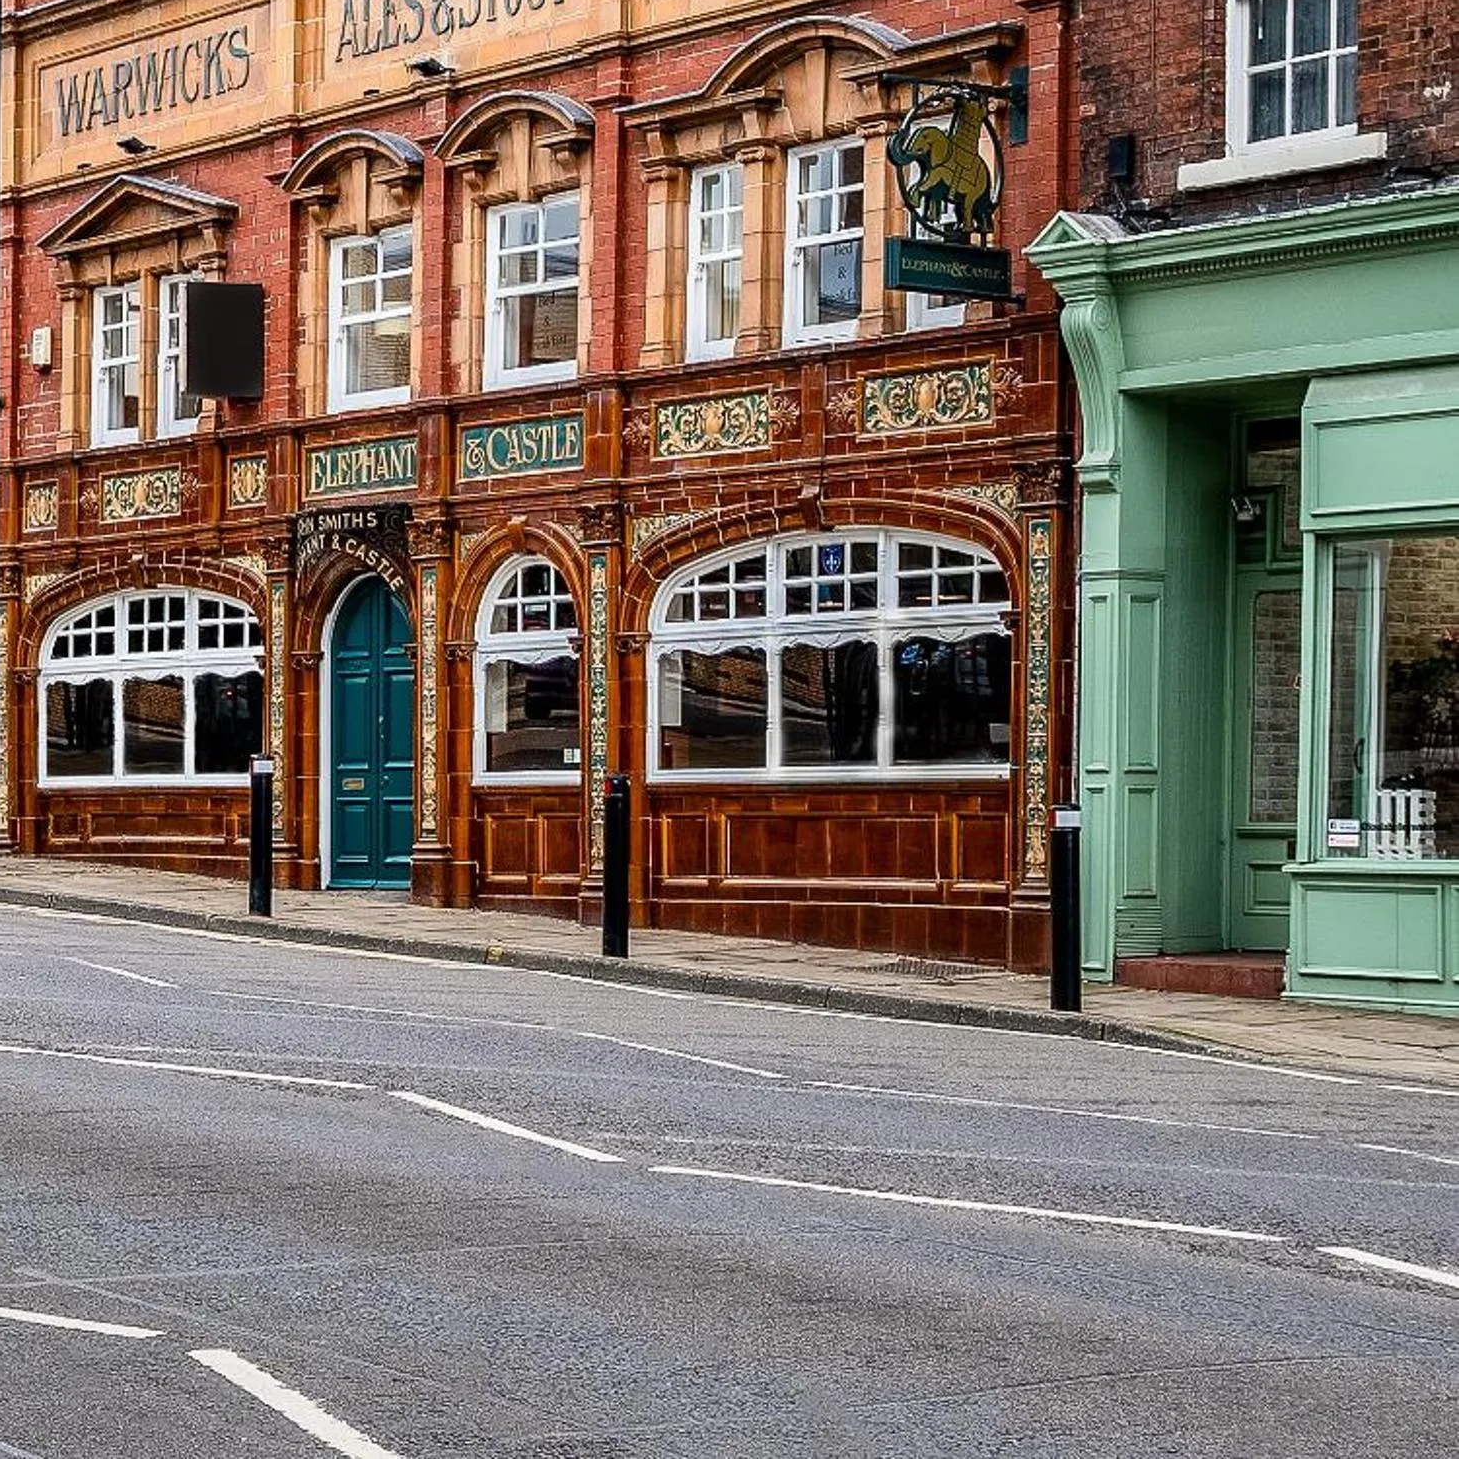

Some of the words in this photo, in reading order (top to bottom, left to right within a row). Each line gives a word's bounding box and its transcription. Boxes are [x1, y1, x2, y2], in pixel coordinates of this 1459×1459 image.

[55, 25, 252, 137] WARWICKS
[310, 442, 418, 493] ELEPHANT
[466, 437, 486, 475] &
[486, 421, 581, 472] CASTLE
[318, 511, 378, 530] SMITHS
[332, 533, 341, 551] &
[345, 538, 404, 592] CASTLE
